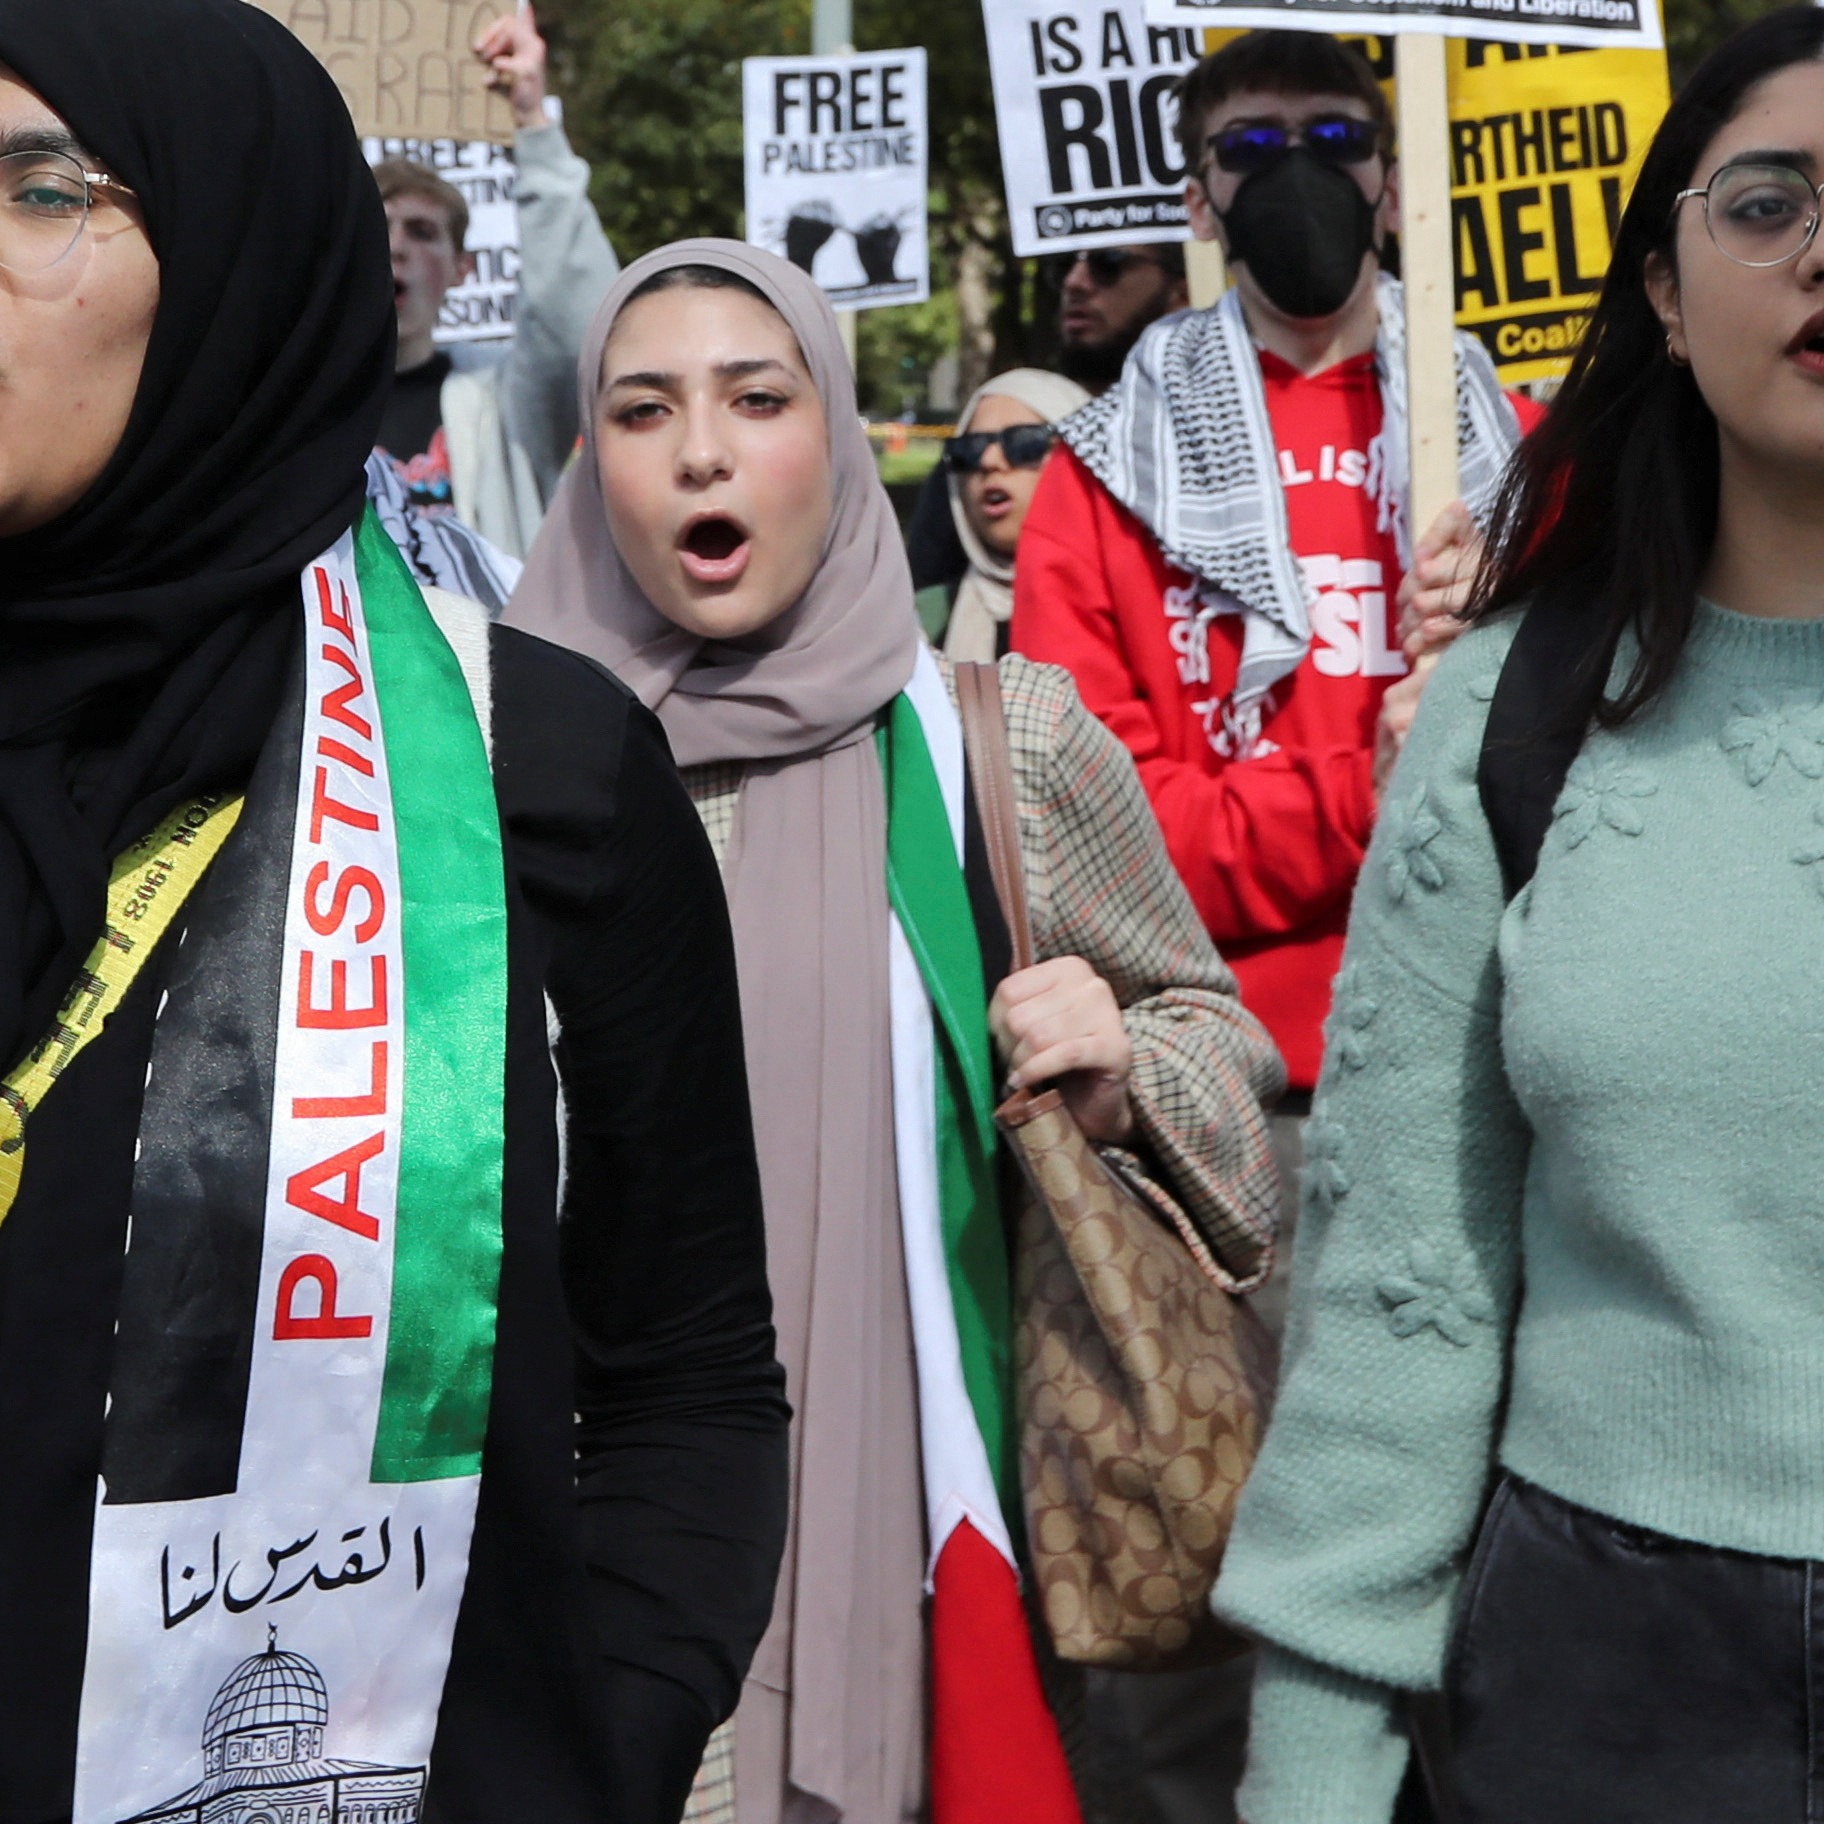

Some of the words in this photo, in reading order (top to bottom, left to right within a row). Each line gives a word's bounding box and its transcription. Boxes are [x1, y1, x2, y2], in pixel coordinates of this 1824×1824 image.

[1029, 16, 1083, 77] IS
[1100, 11, 1136, 70] A
[774, 65, 906, 135] FREE
[763, 133, 915, 174] PALESTINE
[1451, 101, 1629, 187] RTHEID
[1303, 591, 1409, 677] SL
[272, 564, 388, 1342] PALESTINE
[160, 1531, 221, 1630] لنا
[222, 1515, 426, 1614] القدس
